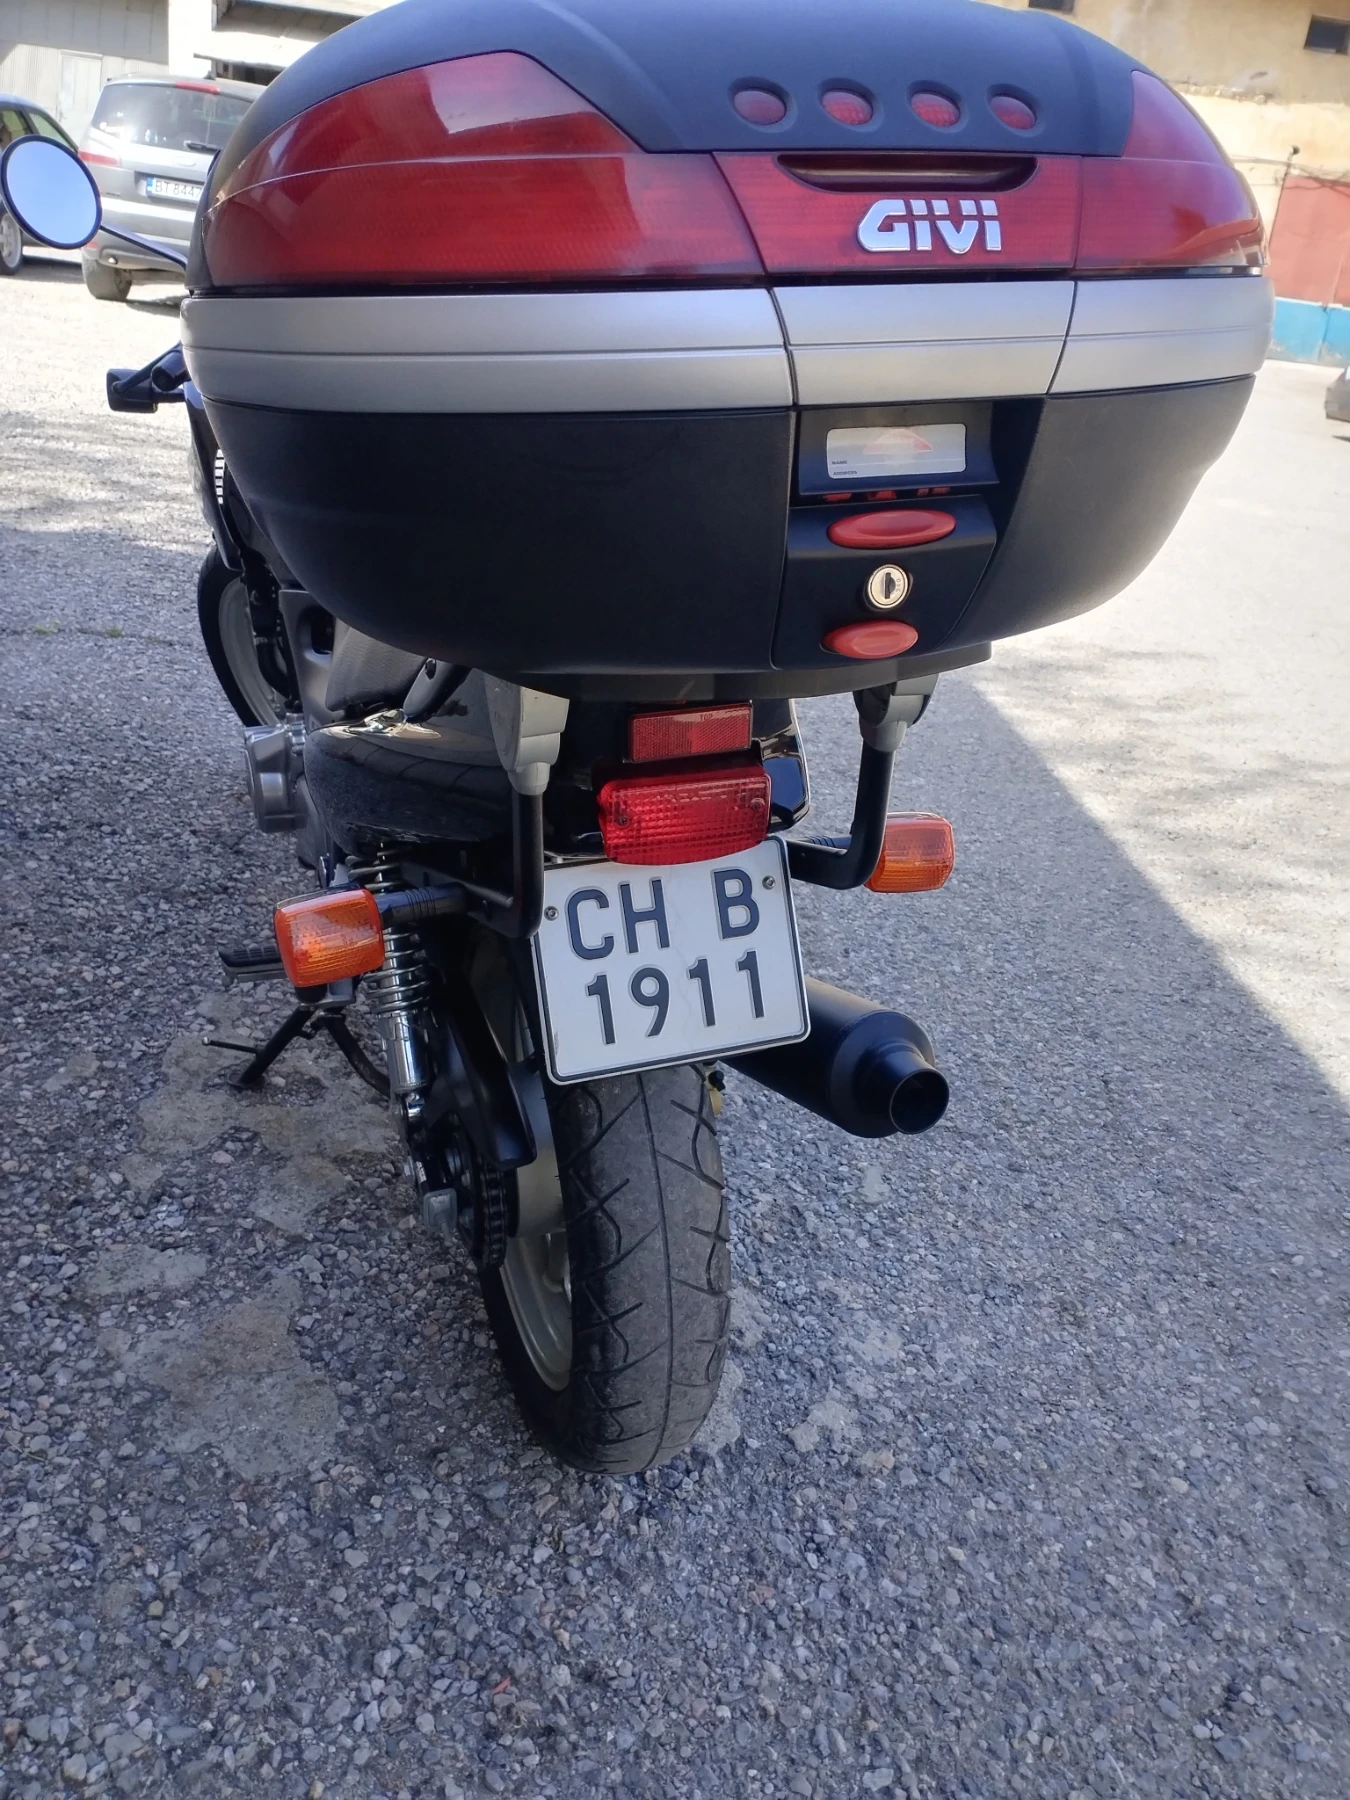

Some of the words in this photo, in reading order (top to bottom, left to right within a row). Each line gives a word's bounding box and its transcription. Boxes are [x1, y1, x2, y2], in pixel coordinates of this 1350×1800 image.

[858, 199, 1002, 254] GIVI
[567, 879, 670, 960] CH
[713, 868, 760, 940] B
[587, 950, 765, 1045] 1911
